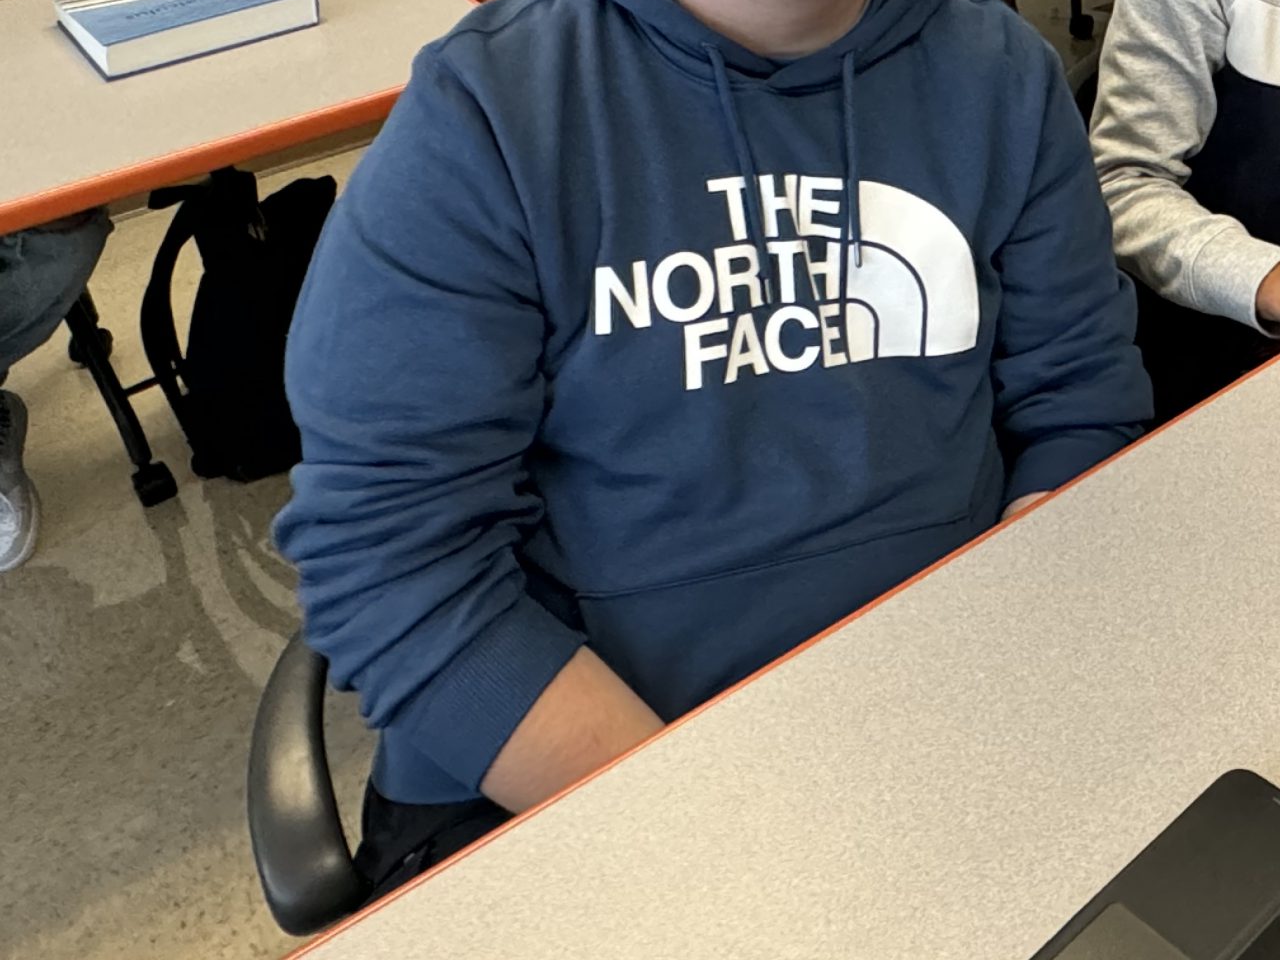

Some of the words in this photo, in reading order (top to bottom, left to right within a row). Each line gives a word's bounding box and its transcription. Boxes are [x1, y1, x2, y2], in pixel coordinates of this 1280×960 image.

[706, 174, 844, 241] THE
[594, 239, 842, 336] NORTH
[683, 304, 849, 391] FACE
